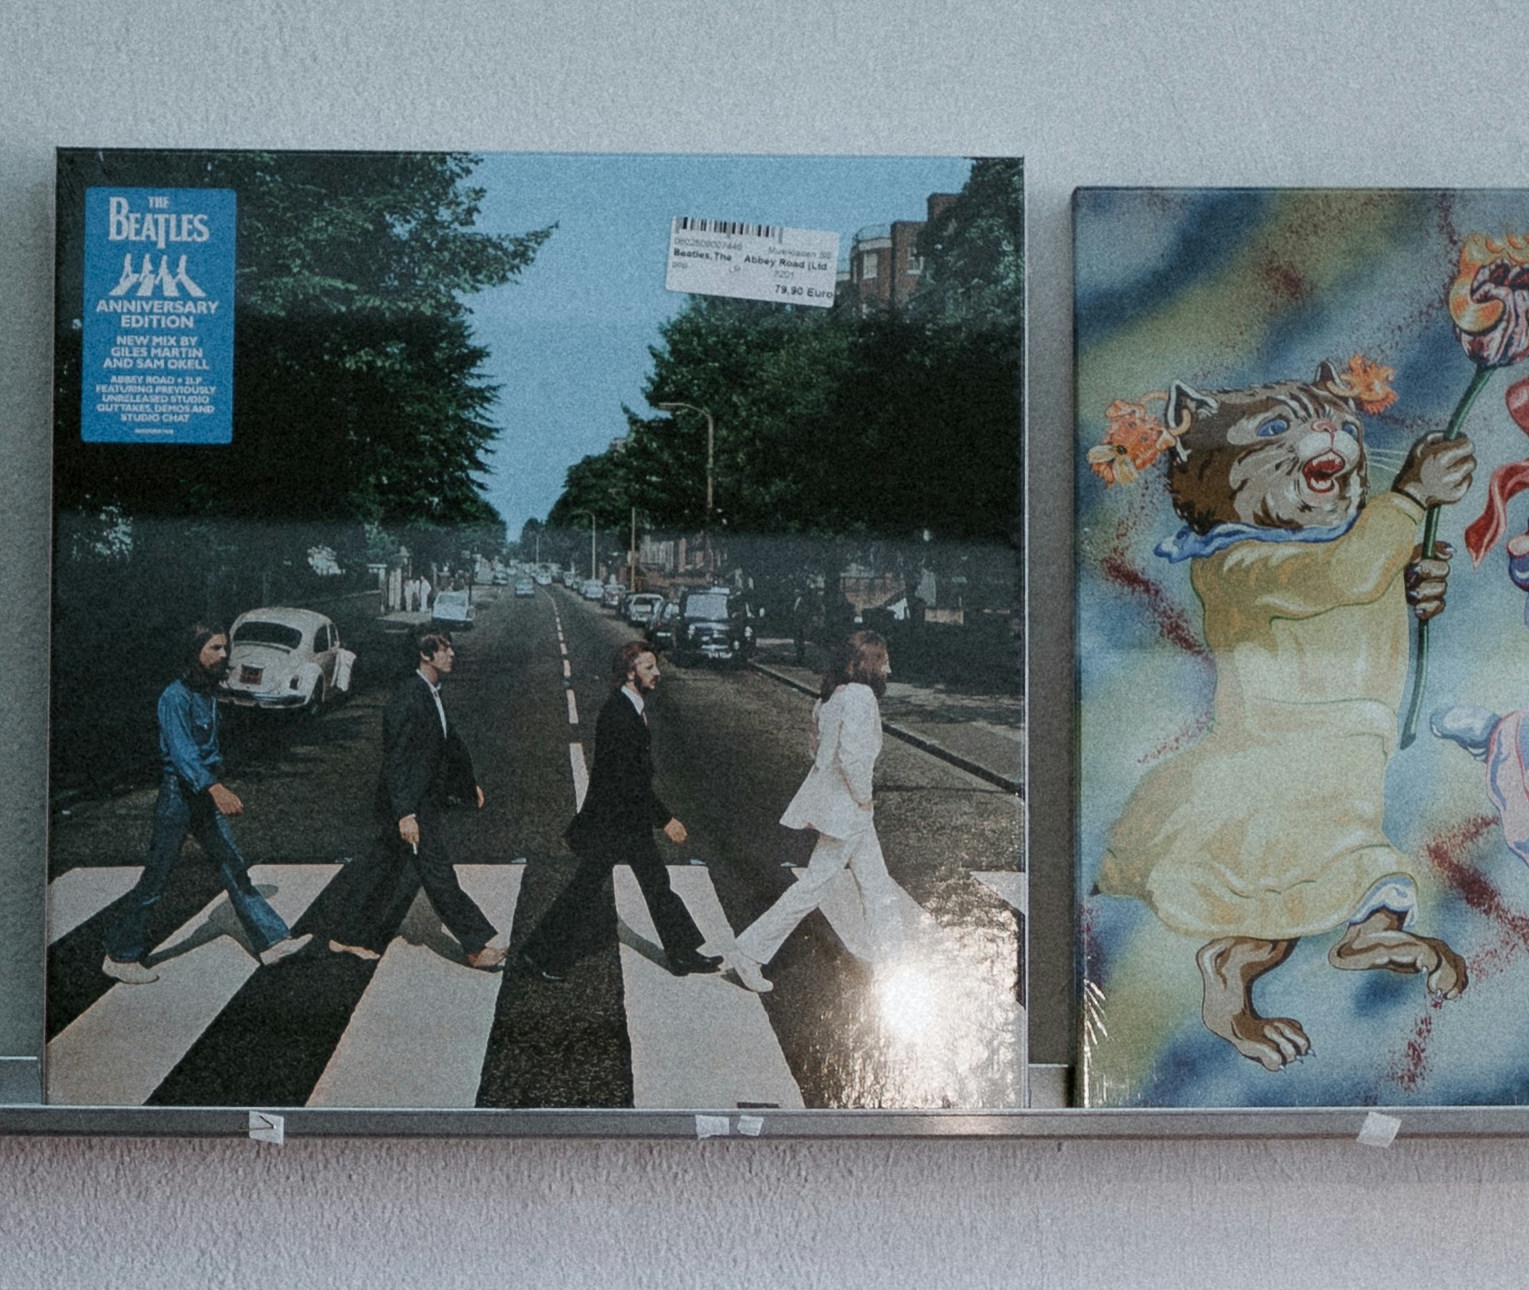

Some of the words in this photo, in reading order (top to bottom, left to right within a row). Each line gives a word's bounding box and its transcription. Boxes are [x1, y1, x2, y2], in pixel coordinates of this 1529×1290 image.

[148, 196, 169, 208] THE
[108, 197, 210, 249] BEATLES
[807, 287, 833, 299] Euro
[96, 300, 220, 314] ANNIVERSARY
[121, 315, 194, 328] EDITION
[116, 336, 149, 346] NEW
[152, 336, 176, 346] MIX
[181, 336, 198, 346] BY
[111, 347, 148, 357] GILES
[151, 348, 203, 358] MARTIN
[103, 358, 133, 368] AND
[136, 359, 164, 368] SAM
[168, 359, 210, 369] OKELL
